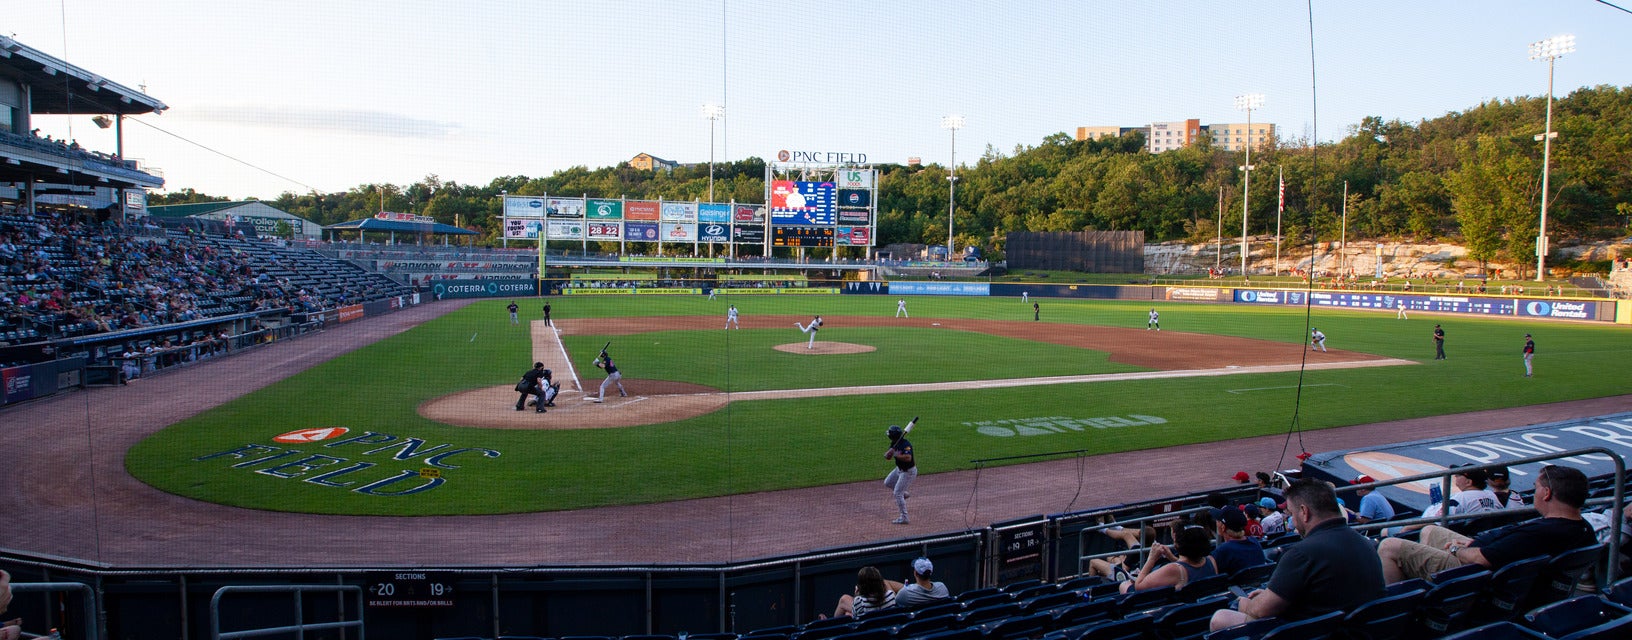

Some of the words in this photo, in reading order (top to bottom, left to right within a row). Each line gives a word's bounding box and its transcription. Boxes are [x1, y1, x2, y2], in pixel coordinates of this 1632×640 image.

[793, 151, 822, 162] PNC
[827, 151, 867, 163] FIELD
[700, 208, 730, 218] Geisinger
[606, 227, 618, 235] 22
[1551, 302, 1584, 310] United
[1550, 310, 1587, 318] Rentals
[976, 414, 1168, 437] OATFIELD
[324, 431, 501, 469] PNC
[192, 443, 447, 496] FIELD
[1478, 498, 1494, 509] RUTH
[1014, 530, 1034, 540] SECTIONS
[1012, 542, 1020, 550] 19
[1027, 539, 1034, 547] 18
[378, 583, 395, 596] 20
[430, 583, 444, 596] 19
